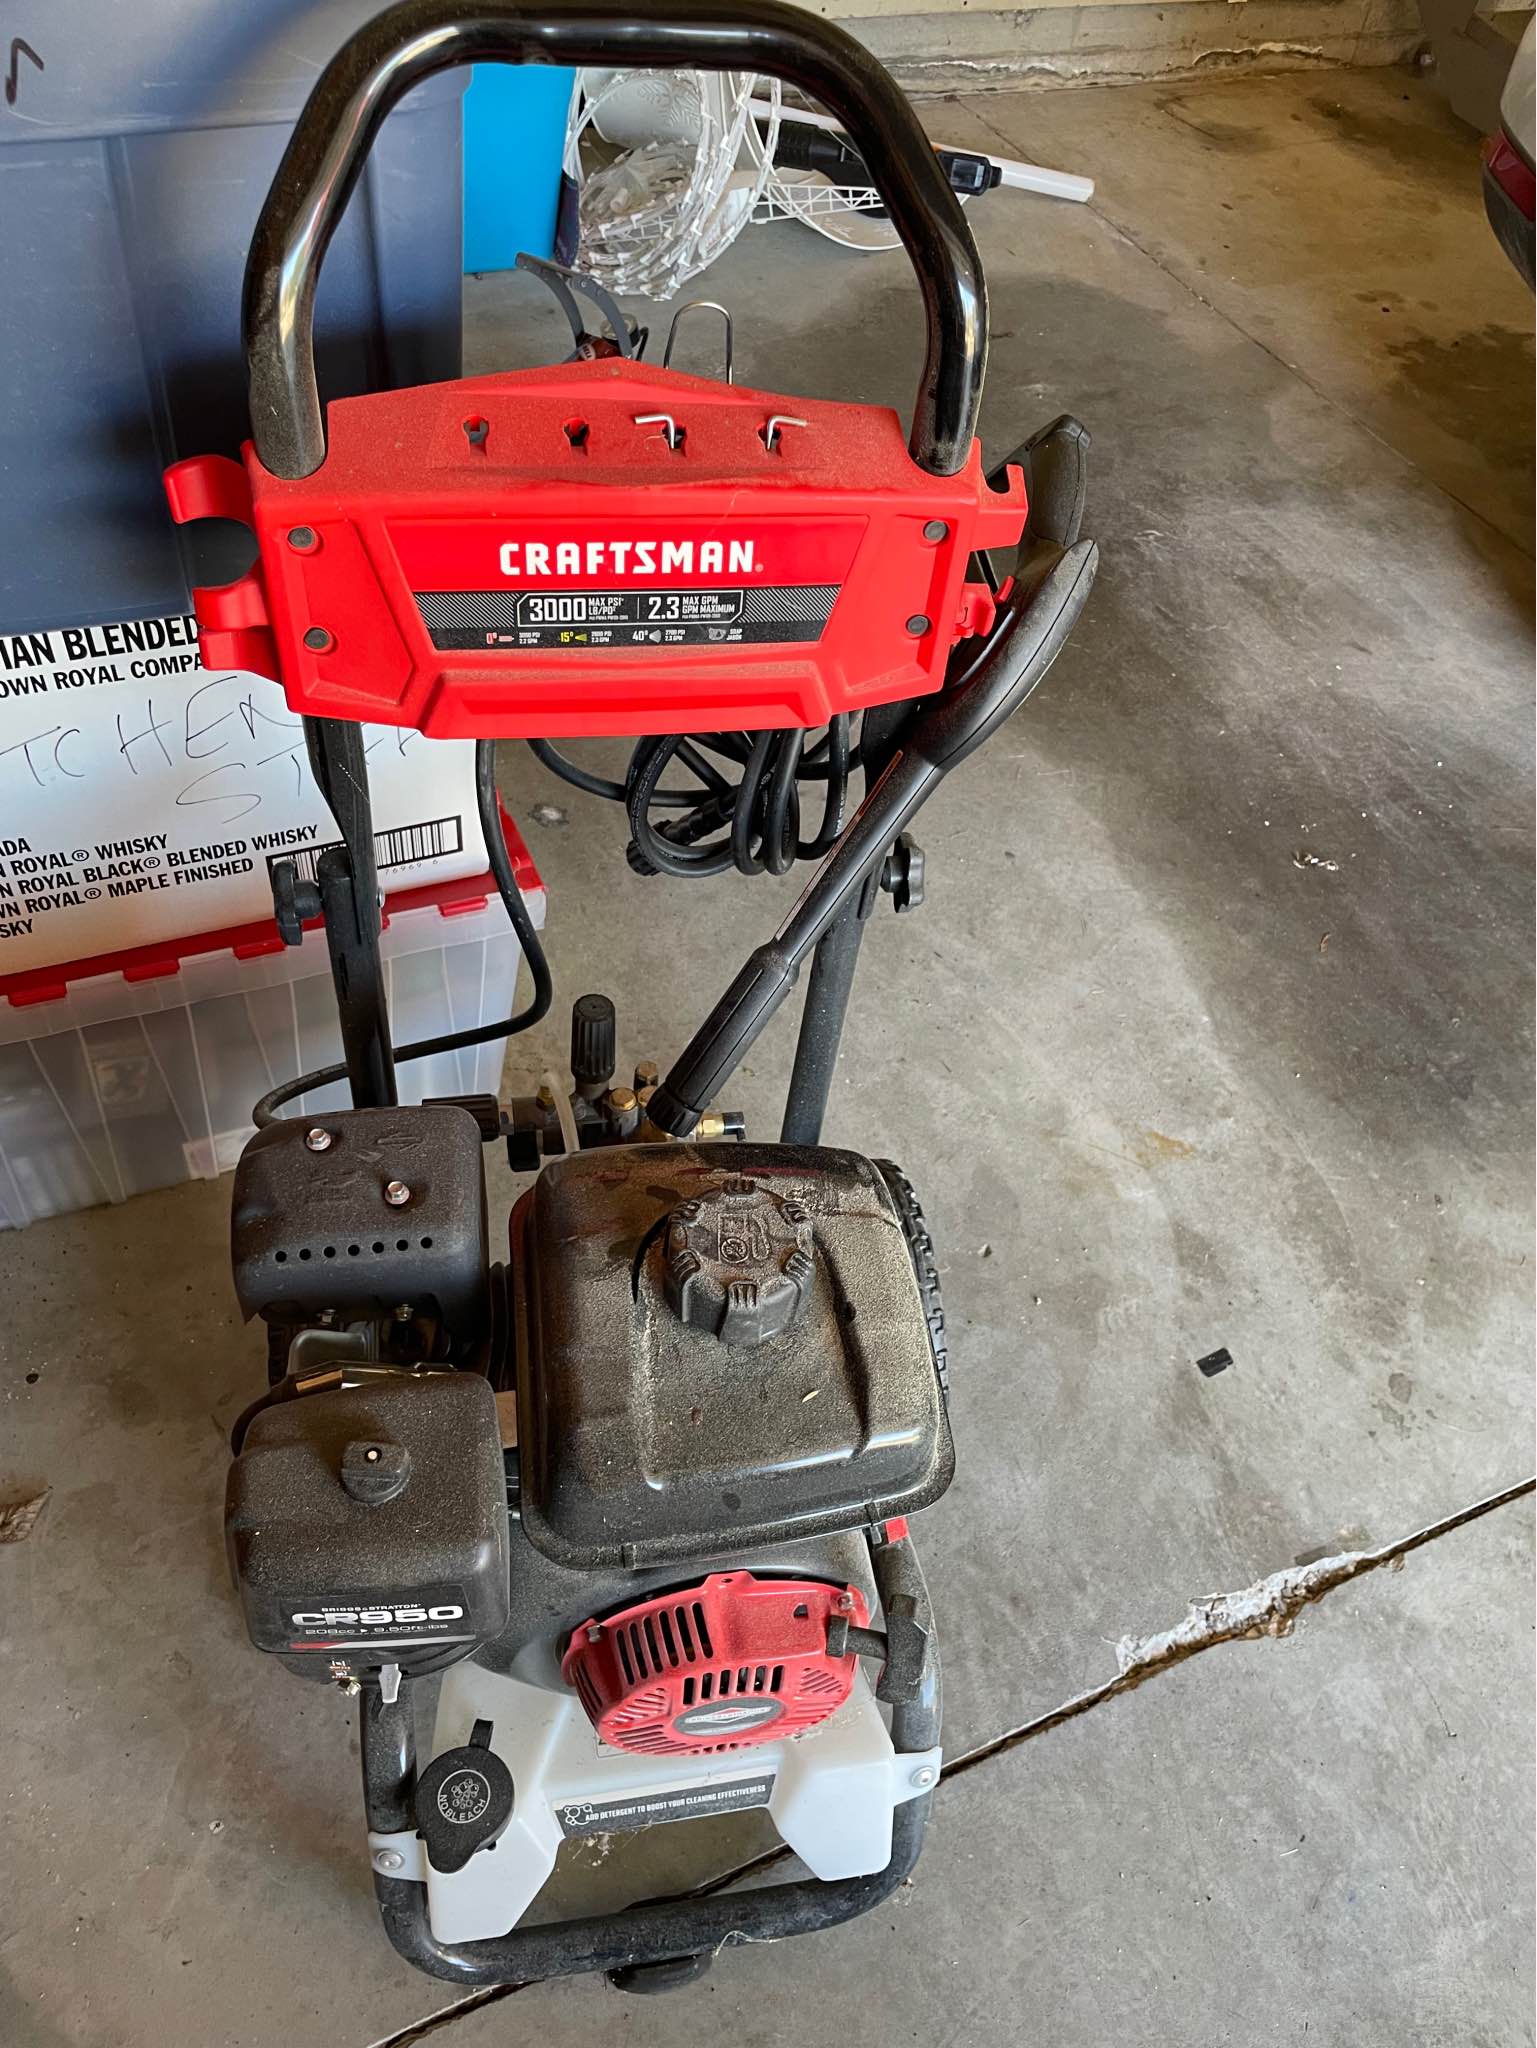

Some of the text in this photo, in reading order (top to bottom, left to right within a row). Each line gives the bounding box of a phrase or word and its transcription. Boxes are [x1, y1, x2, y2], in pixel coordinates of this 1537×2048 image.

[500, 540, 754, 576] CRAFTSMAN
[529, 597, 587, 621] 3000
[588, 597, 606, 606] MAX
[648, 596, 680, 619] 2.3
[682, 596, 700, 605] MAX
[701, 595, 719, 605] GPM
[682, 604, 735, 614] GPM MAXIMUM
[632, 629, 648, 641] 40°
[53, 664, 125, 690] ROYAL
[20, 868, 79, 895] ROYAL
[168, 840, 247, 867] BLENDED
[251, 825, 318, 851] WHISKY
[95, 834, 168, 860] WHISKY
[107, 873, 170, 898] MAPLE
[175, 858, 253, 886] FINISHED
[292, 1605, 464, 1626] CR950
[585, 1784, 766, 1821] ADD DETERGENT TO BOOST YOUR CLEANING EFFECTIVENESS
